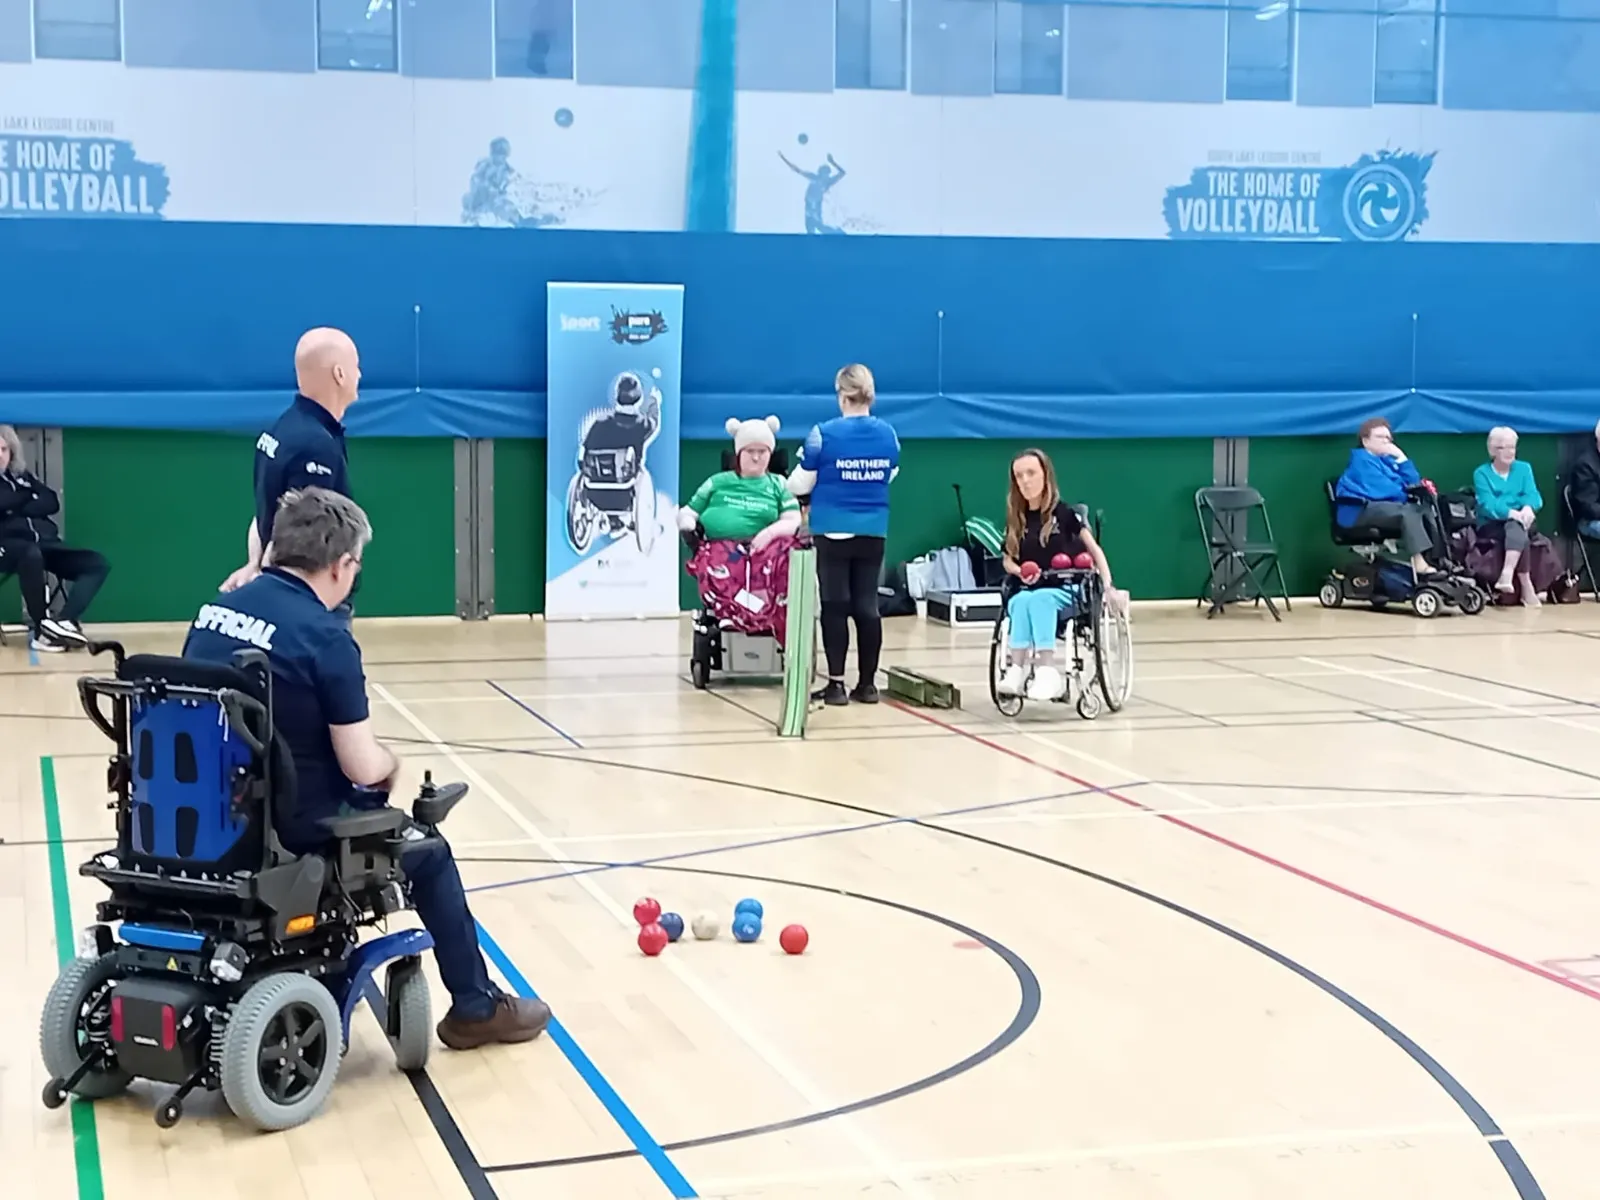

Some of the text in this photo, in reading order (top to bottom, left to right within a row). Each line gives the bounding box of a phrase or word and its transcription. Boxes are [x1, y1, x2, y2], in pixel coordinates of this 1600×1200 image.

[16, 140, 82, 170] HOME
[89, 143, 116, 172] OF
[1207, 171, 1321, 199] THE HOME OF
[1176, 197, 1320, 233] VOLLEYBALL
[835, 458, 890, 470] NORTHERN
[841, 470, 885, 481] IRELAND
[194, 603, 277, 651] OFFICIAL
